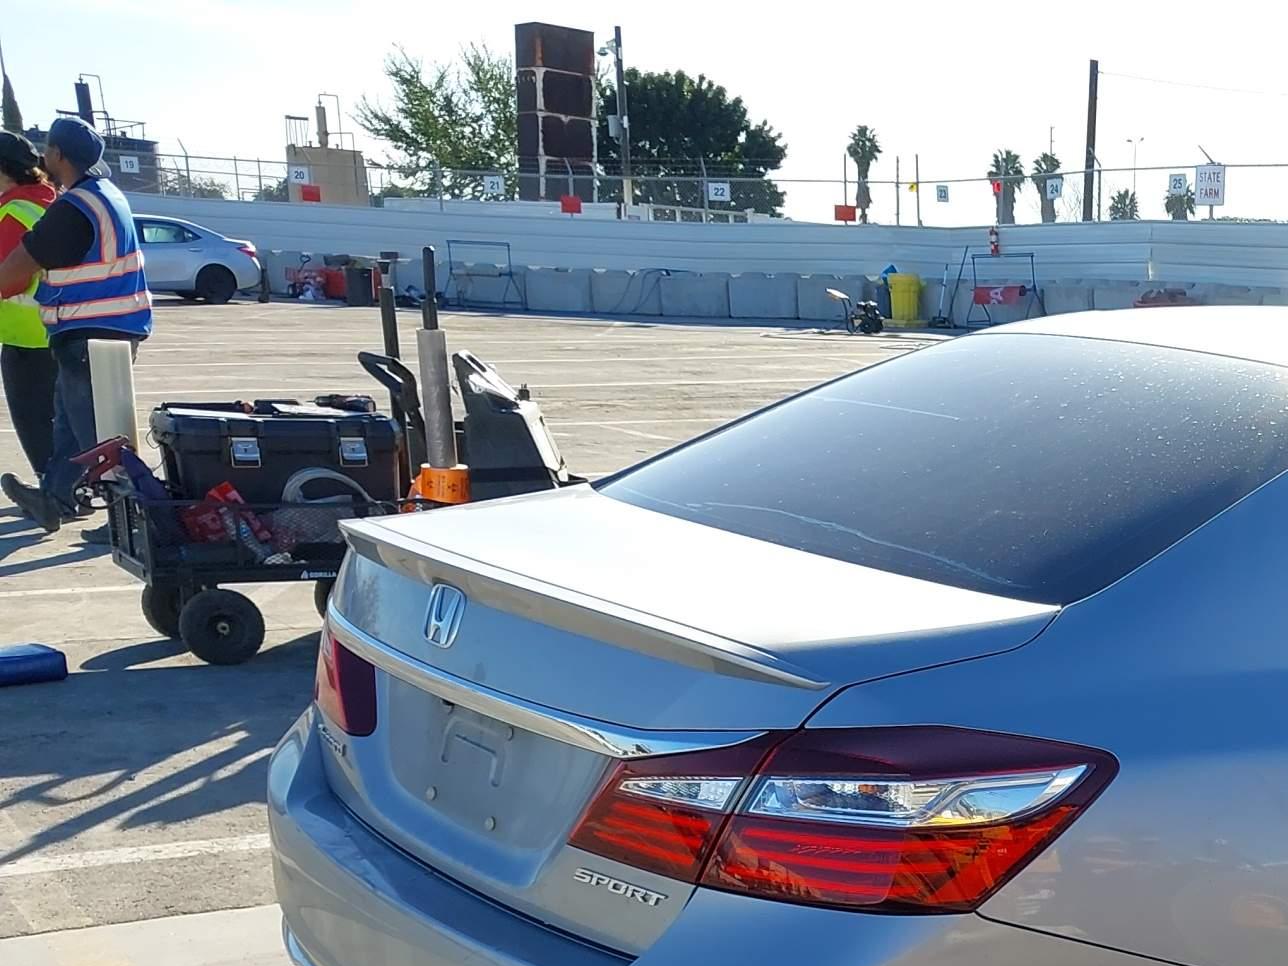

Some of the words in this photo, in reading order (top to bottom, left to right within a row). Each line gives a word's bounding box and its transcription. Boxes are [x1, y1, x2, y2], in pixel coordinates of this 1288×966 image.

[125, 160, 134, 169] 19
[294, 170, 305, 180] 20
[1199, 171, 1221, 183] STATE
[489, 180, 500, 190] 21
[1050, 183, 1059, 195] 24
[1172, 178, 1183, 190] 25
[713, 187, 725, 197] 22
[1199, 187, 1220, 199] FARM
[573, 867, 669, 907] SPORT
